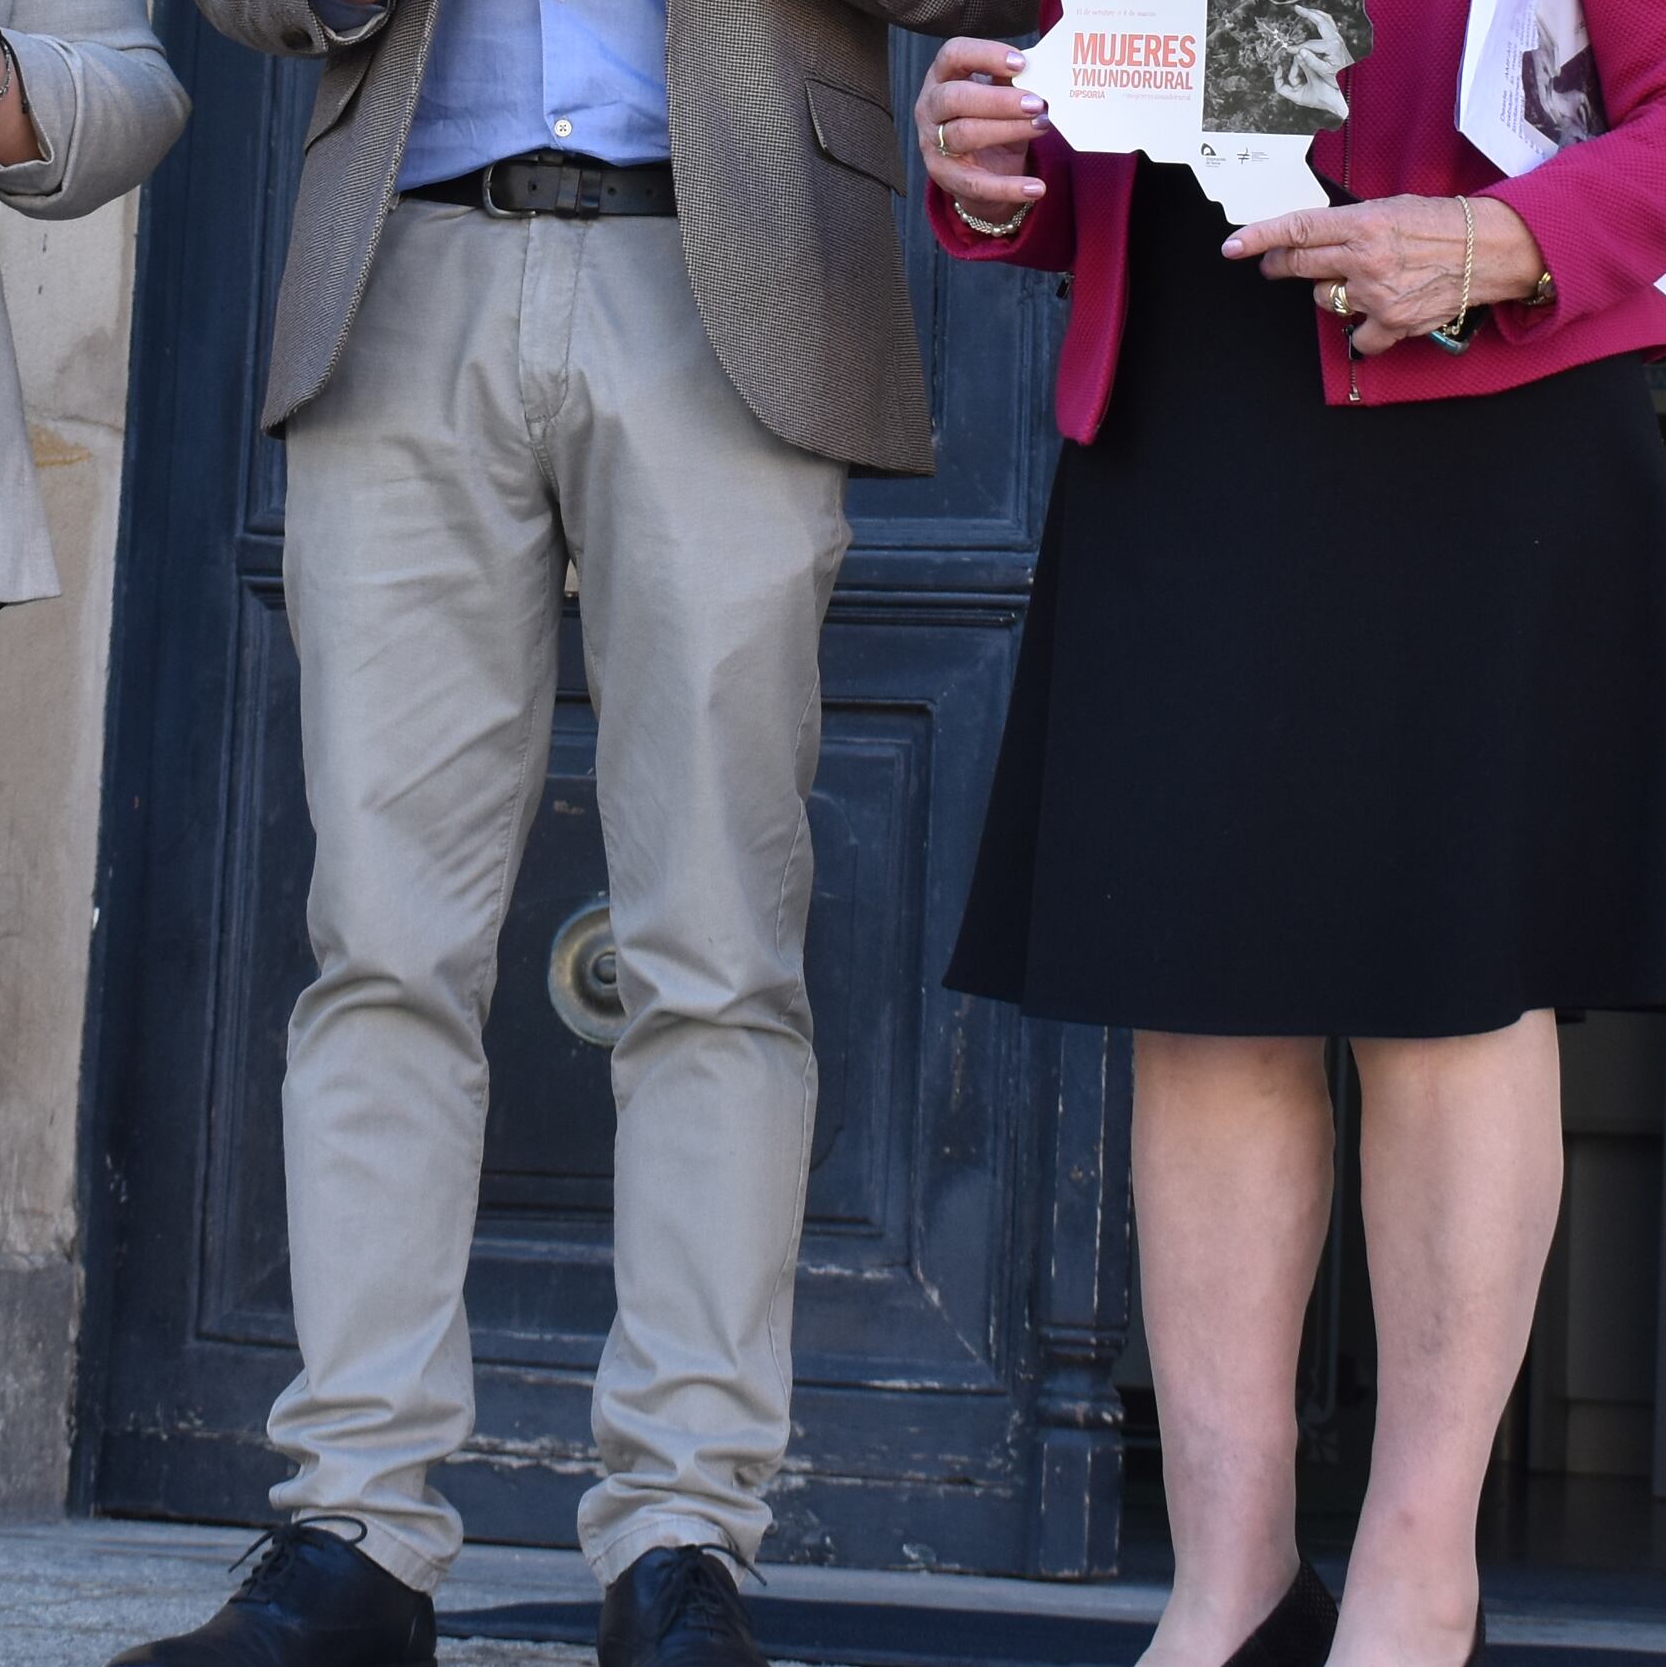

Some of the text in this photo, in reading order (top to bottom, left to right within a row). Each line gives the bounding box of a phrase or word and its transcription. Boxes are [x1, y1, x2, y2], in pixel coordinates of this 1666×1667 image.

[1072, 32, 1196, 68] MUJERES
[1072, 68, 1193, 90] YMUNDORURAL
[1069, 89, 1105, 99] DIPSORIA
